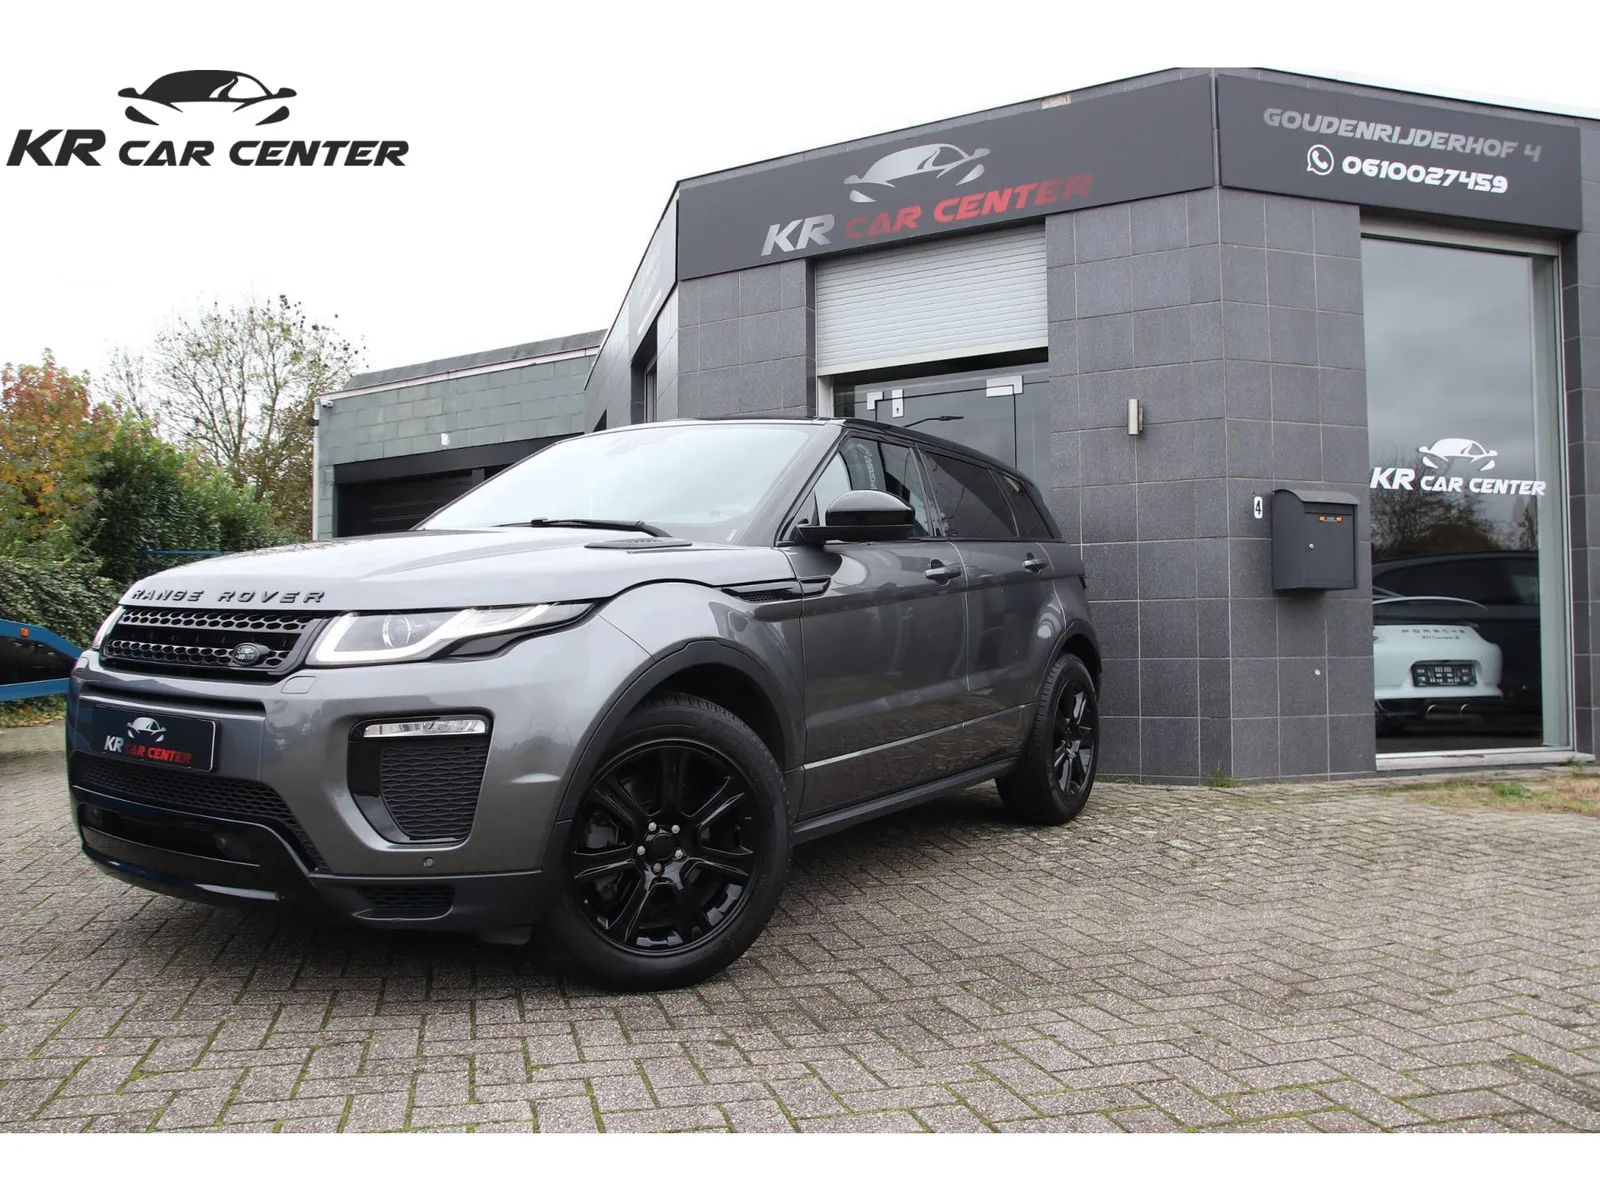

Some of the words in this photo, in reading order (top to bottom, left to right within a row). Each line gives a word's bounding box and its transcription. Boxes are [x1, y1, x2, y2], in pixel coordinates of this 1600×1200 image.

[1263, 107, 1518, 158] GOUDENRIJDERHOF
[1524, 143, 1543, 162] 4
[1342, 156, 1508, 193] 0610027459
[761, 213, 835, 256] KR
[845, 205, 922, 239] CAR
[933, 173, 1094, 223] CENTER
[1369, 466, 1416, 490] KR
[1420, 475, 1464, 492] CAR
[1469, 477, 1547, 496] CENTER
[131, 589, 205, 602] RANGE
[217, 591, 326, 604] ROVER
[104, 735, 125, 753] KR
[124, 743, 146, 757] CAR
[147, 747, 193, 764] CENTER
